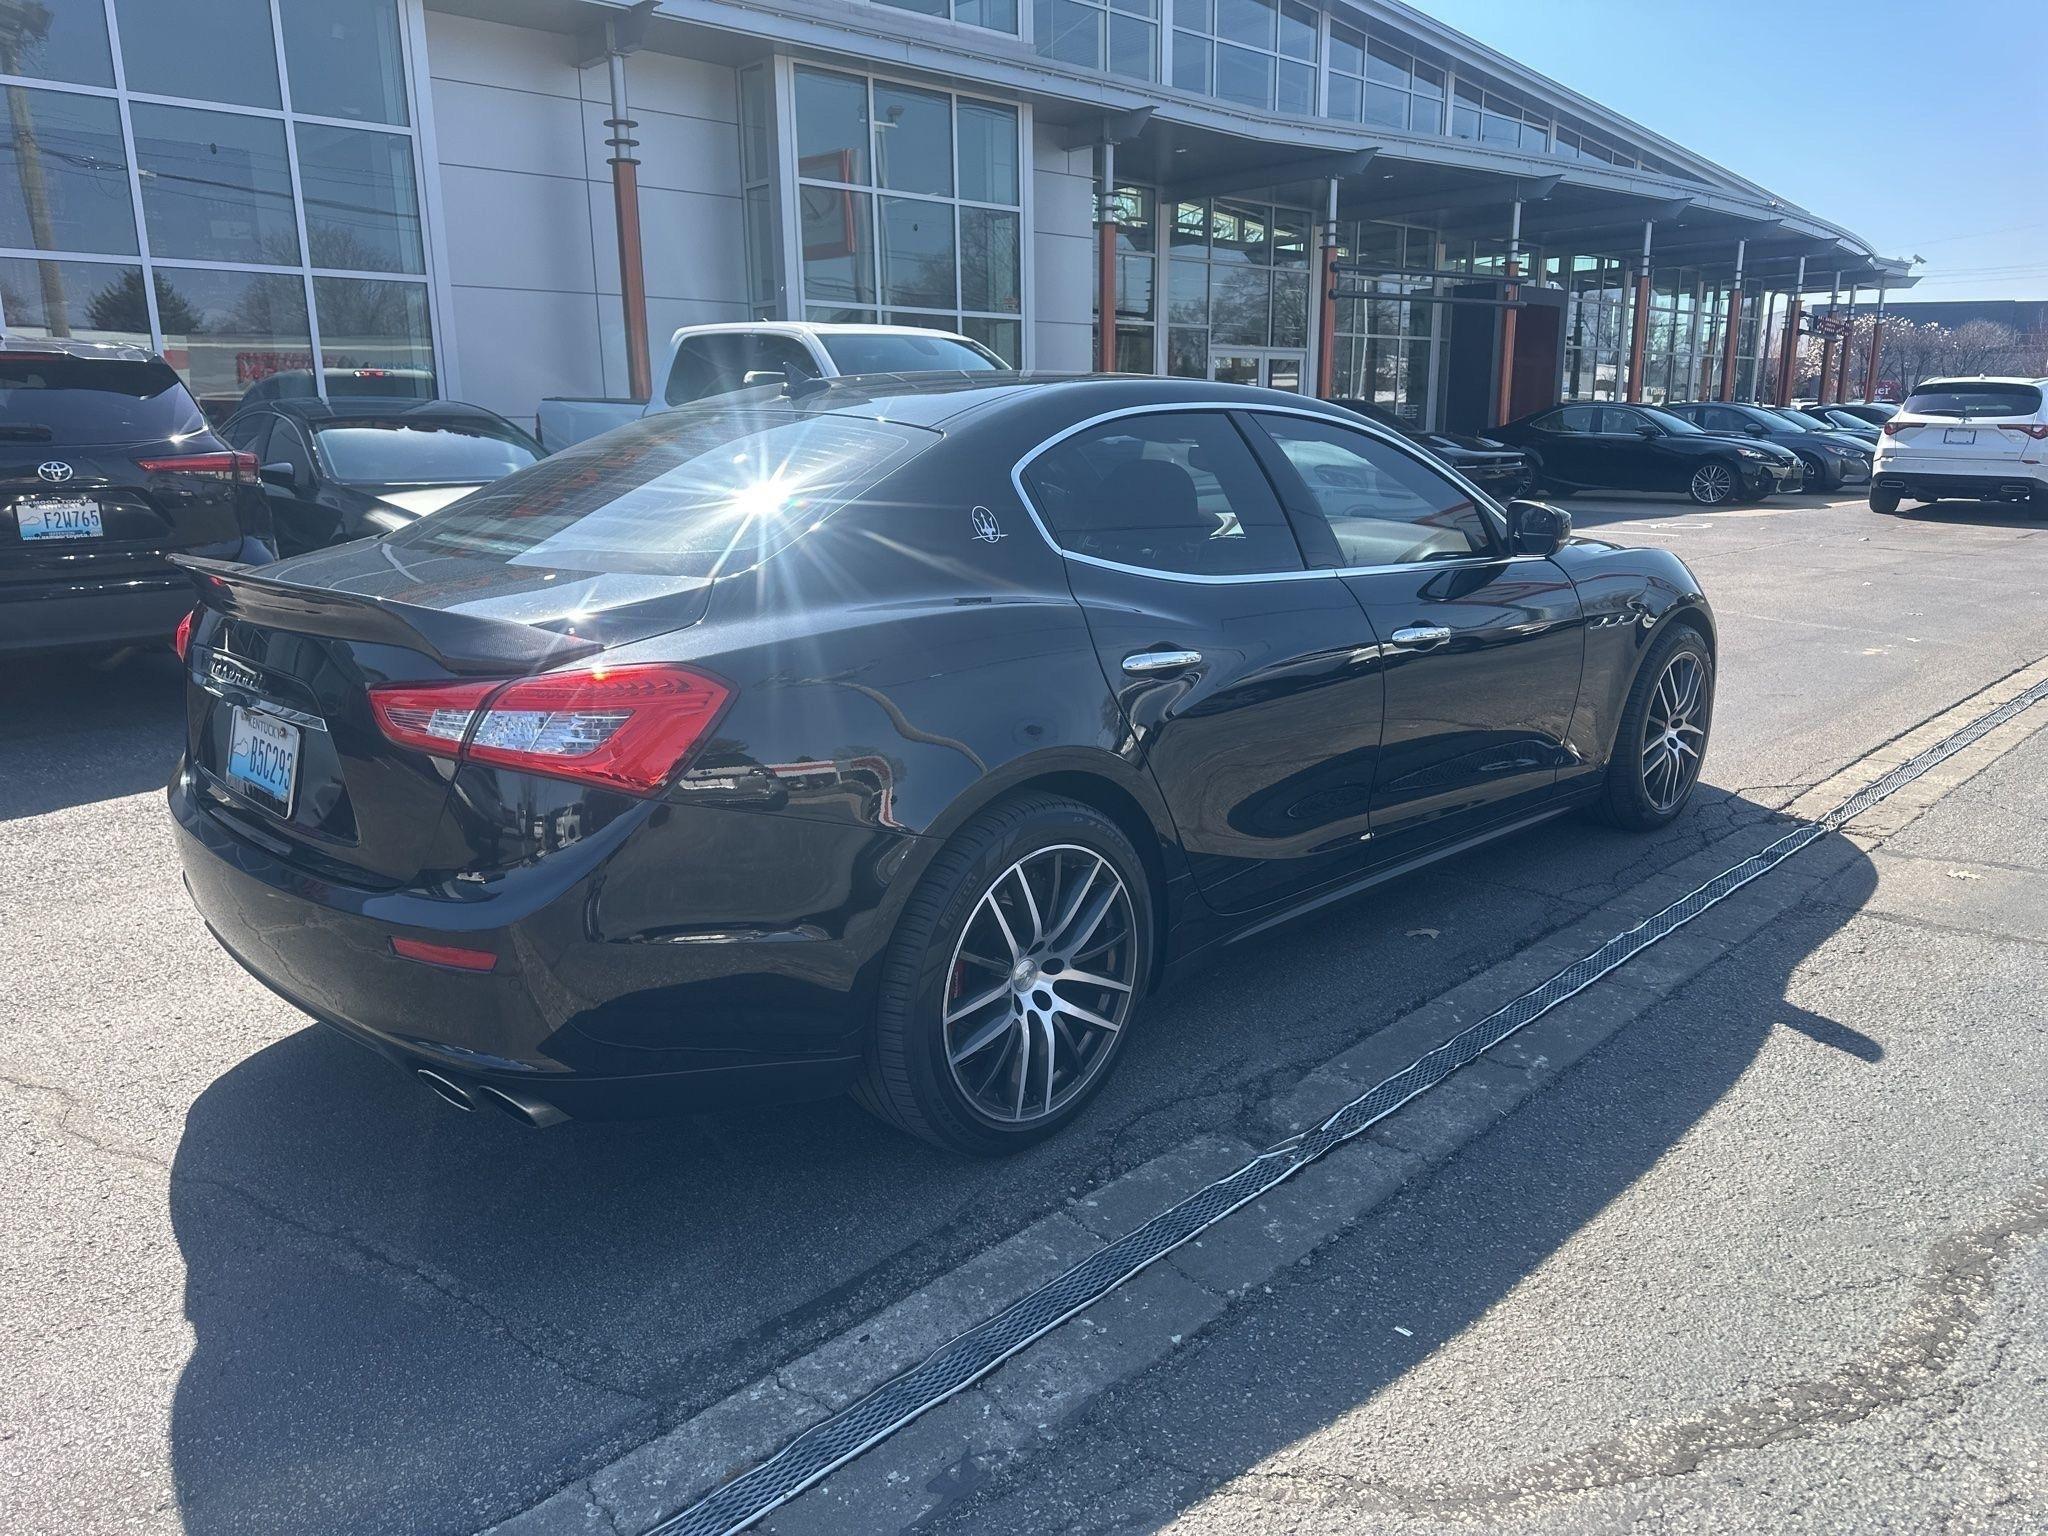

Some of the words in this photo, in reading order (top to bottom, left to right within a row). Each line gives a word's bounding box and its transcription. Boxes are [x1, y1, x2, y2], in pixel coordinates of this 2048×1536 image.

[43, 510, 99, 529] F2W765
[248, 717, 281, 739] KENTUCKY
[250, 736, 293, 790] B5C293
